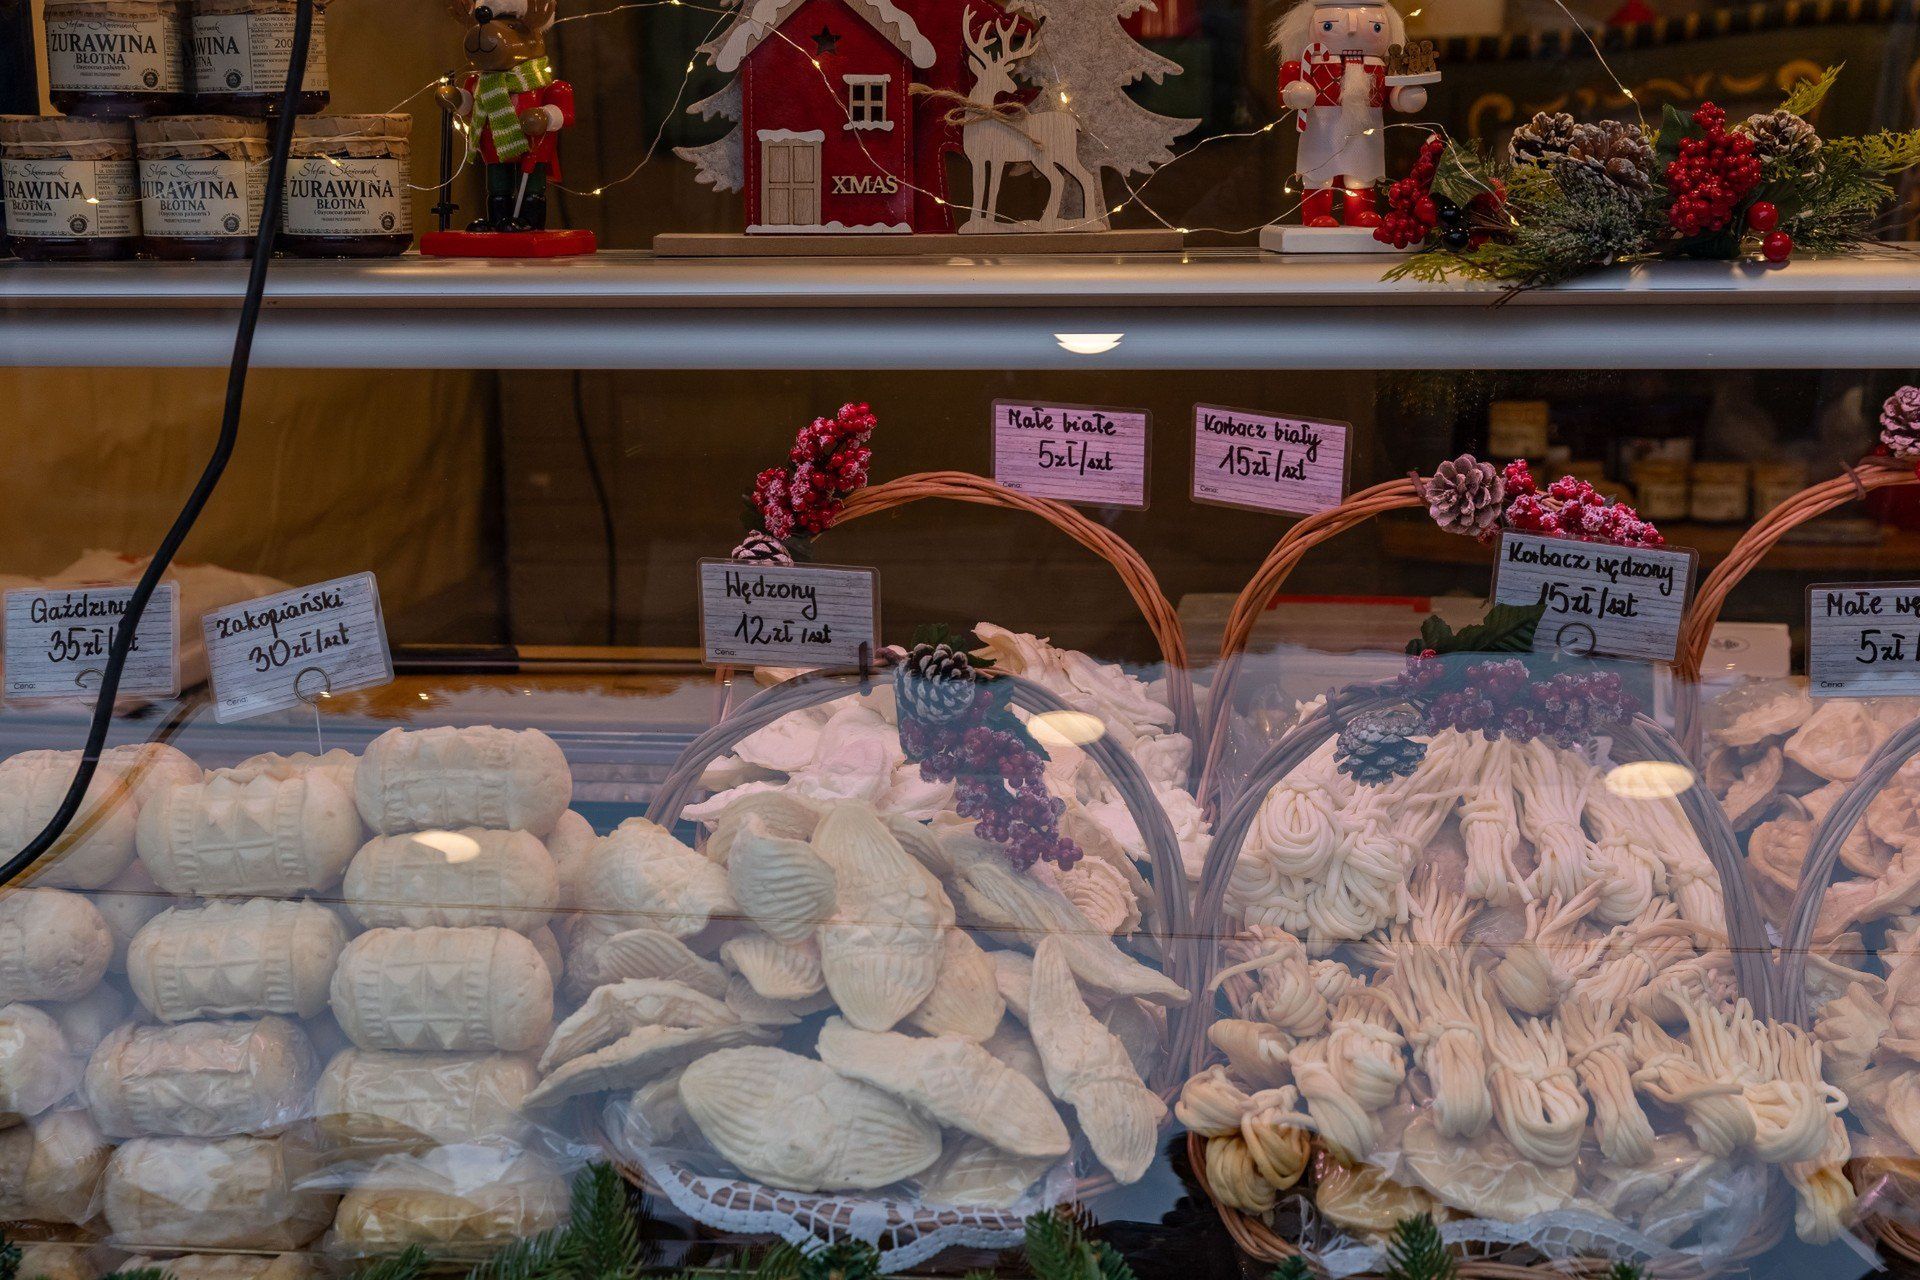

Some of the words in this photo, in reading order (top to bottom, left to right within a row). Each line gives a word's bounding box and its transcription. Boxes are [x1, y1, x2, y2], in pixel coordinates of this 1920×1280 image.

[51, 30, 157, 54] ŻURAWINA
[75, 52, 126, 64] BŁOTNA
[142, 177, 239, 200] ŻURAWINA
[290, 176, 394, 198] ŻURAWINA
[831, 175, 898, 194] XMAS
[12, 199, 52, 211] BŁOTNA
[160, 199, 206, 211] BŁOTNA
[317, 199, 366, 209] BŁOTNA
[1009, 407, 1054, 430] Małe
[1063, 412, 1117, 435] białe
[1204, 414, 1267, 439] Korbacz
[1275, 422, 1322, 463] biały
[1038, 440, 1114, 475] 5zł/szt
[1219, 445, 1306, 482] 15zł/szt
[1508, 541, 1590, 569] Korbacz
[1596, 556, 1673, 596] wędzony
[726, 571, 817, 620] Wędzony
[1827, 592, 1883, 616] Małe
[714, 648, 737, 657] Cena:
[14, 682, 36, 690] Cena:
